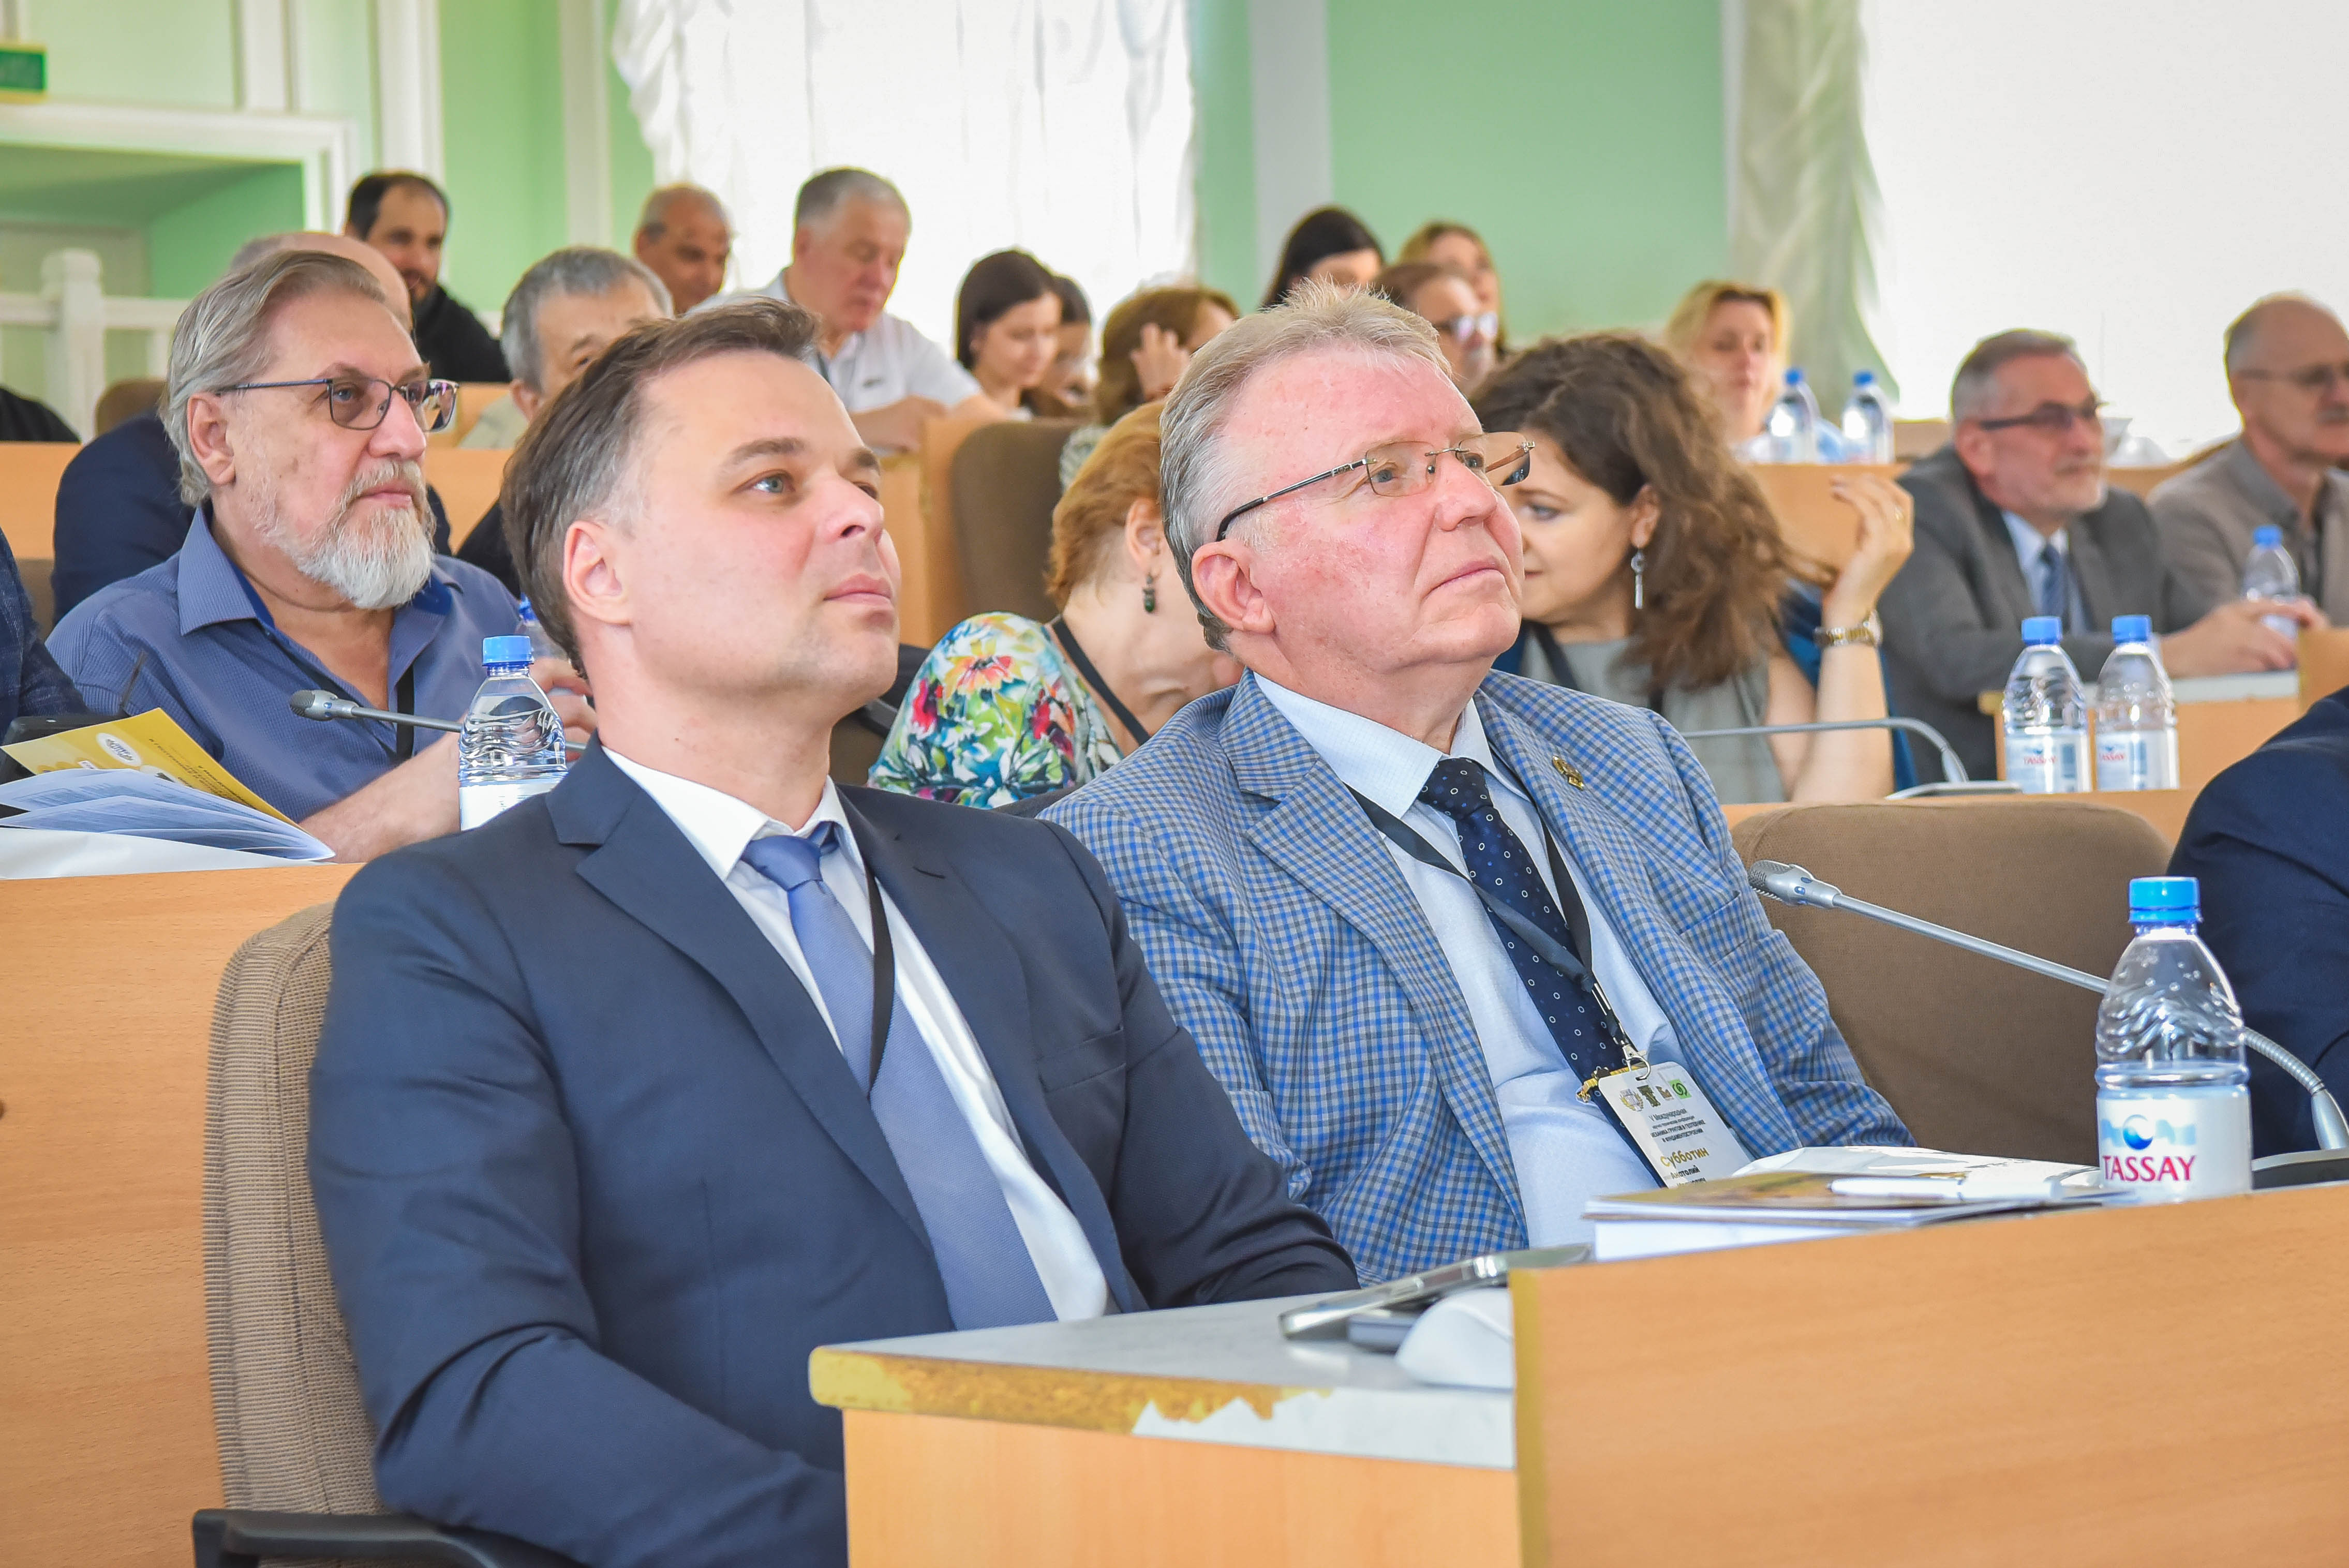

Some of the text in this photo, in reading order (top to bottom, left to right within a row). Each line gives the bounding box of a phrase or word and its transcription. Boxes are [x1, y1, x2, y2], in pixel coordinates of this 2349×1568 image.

[1660, 1147, 1709, 1169] Субботин
[2103, 1155, 2196, 1182] TASSAY
[1670, 1164, 1701, 1179] Анатолий
